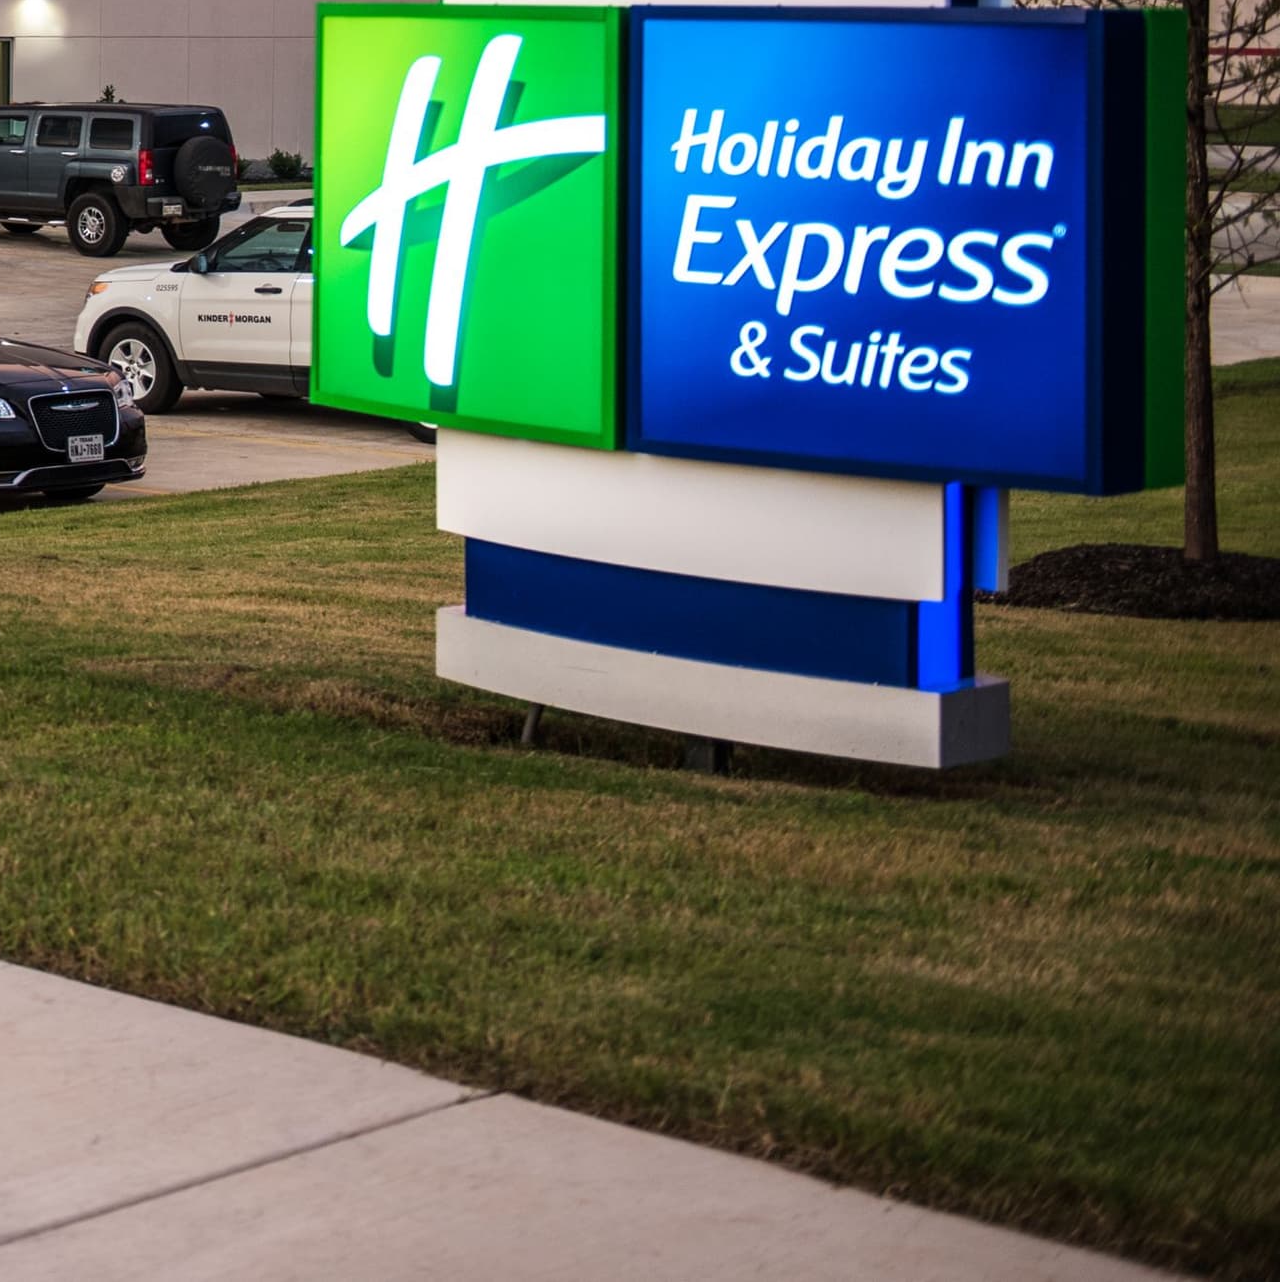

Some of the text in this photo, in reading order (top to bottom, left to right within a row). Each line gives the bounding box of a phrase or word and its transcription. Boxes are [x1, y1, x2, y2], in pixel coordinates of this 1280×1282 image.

[671, 108, 1053, 200] Holiday Inn
[197, 314, 272, 324] KINDER MORGAN
[730, 321, 971, 394] & Suites
